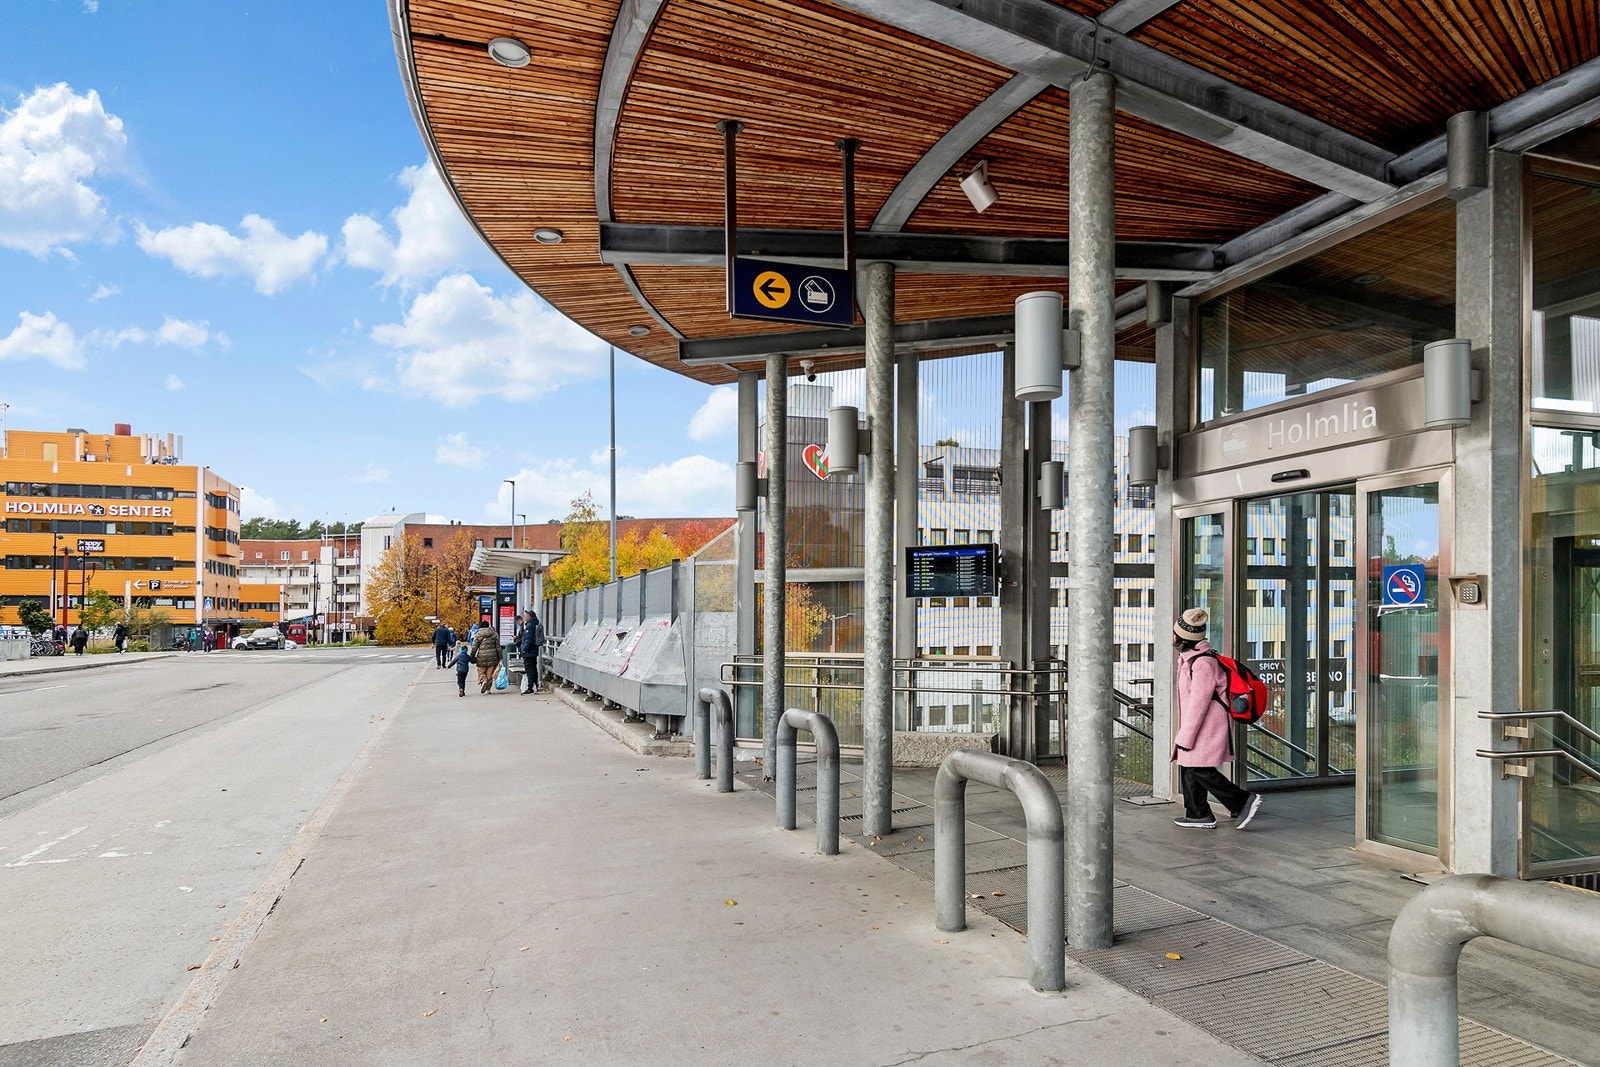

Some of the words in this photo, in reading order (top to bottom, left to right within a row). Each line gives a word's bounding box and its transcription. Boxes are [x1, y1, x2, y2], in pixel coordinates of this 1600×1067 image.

[1268, 401, 1377, 449] Holmlia
[5, 501, 86, 515] HOLMLIA
[108, 504, 172, 517] SENTER
[151, 582, 159, 590] P
[1259, 662, 1280, 671] SPICY
